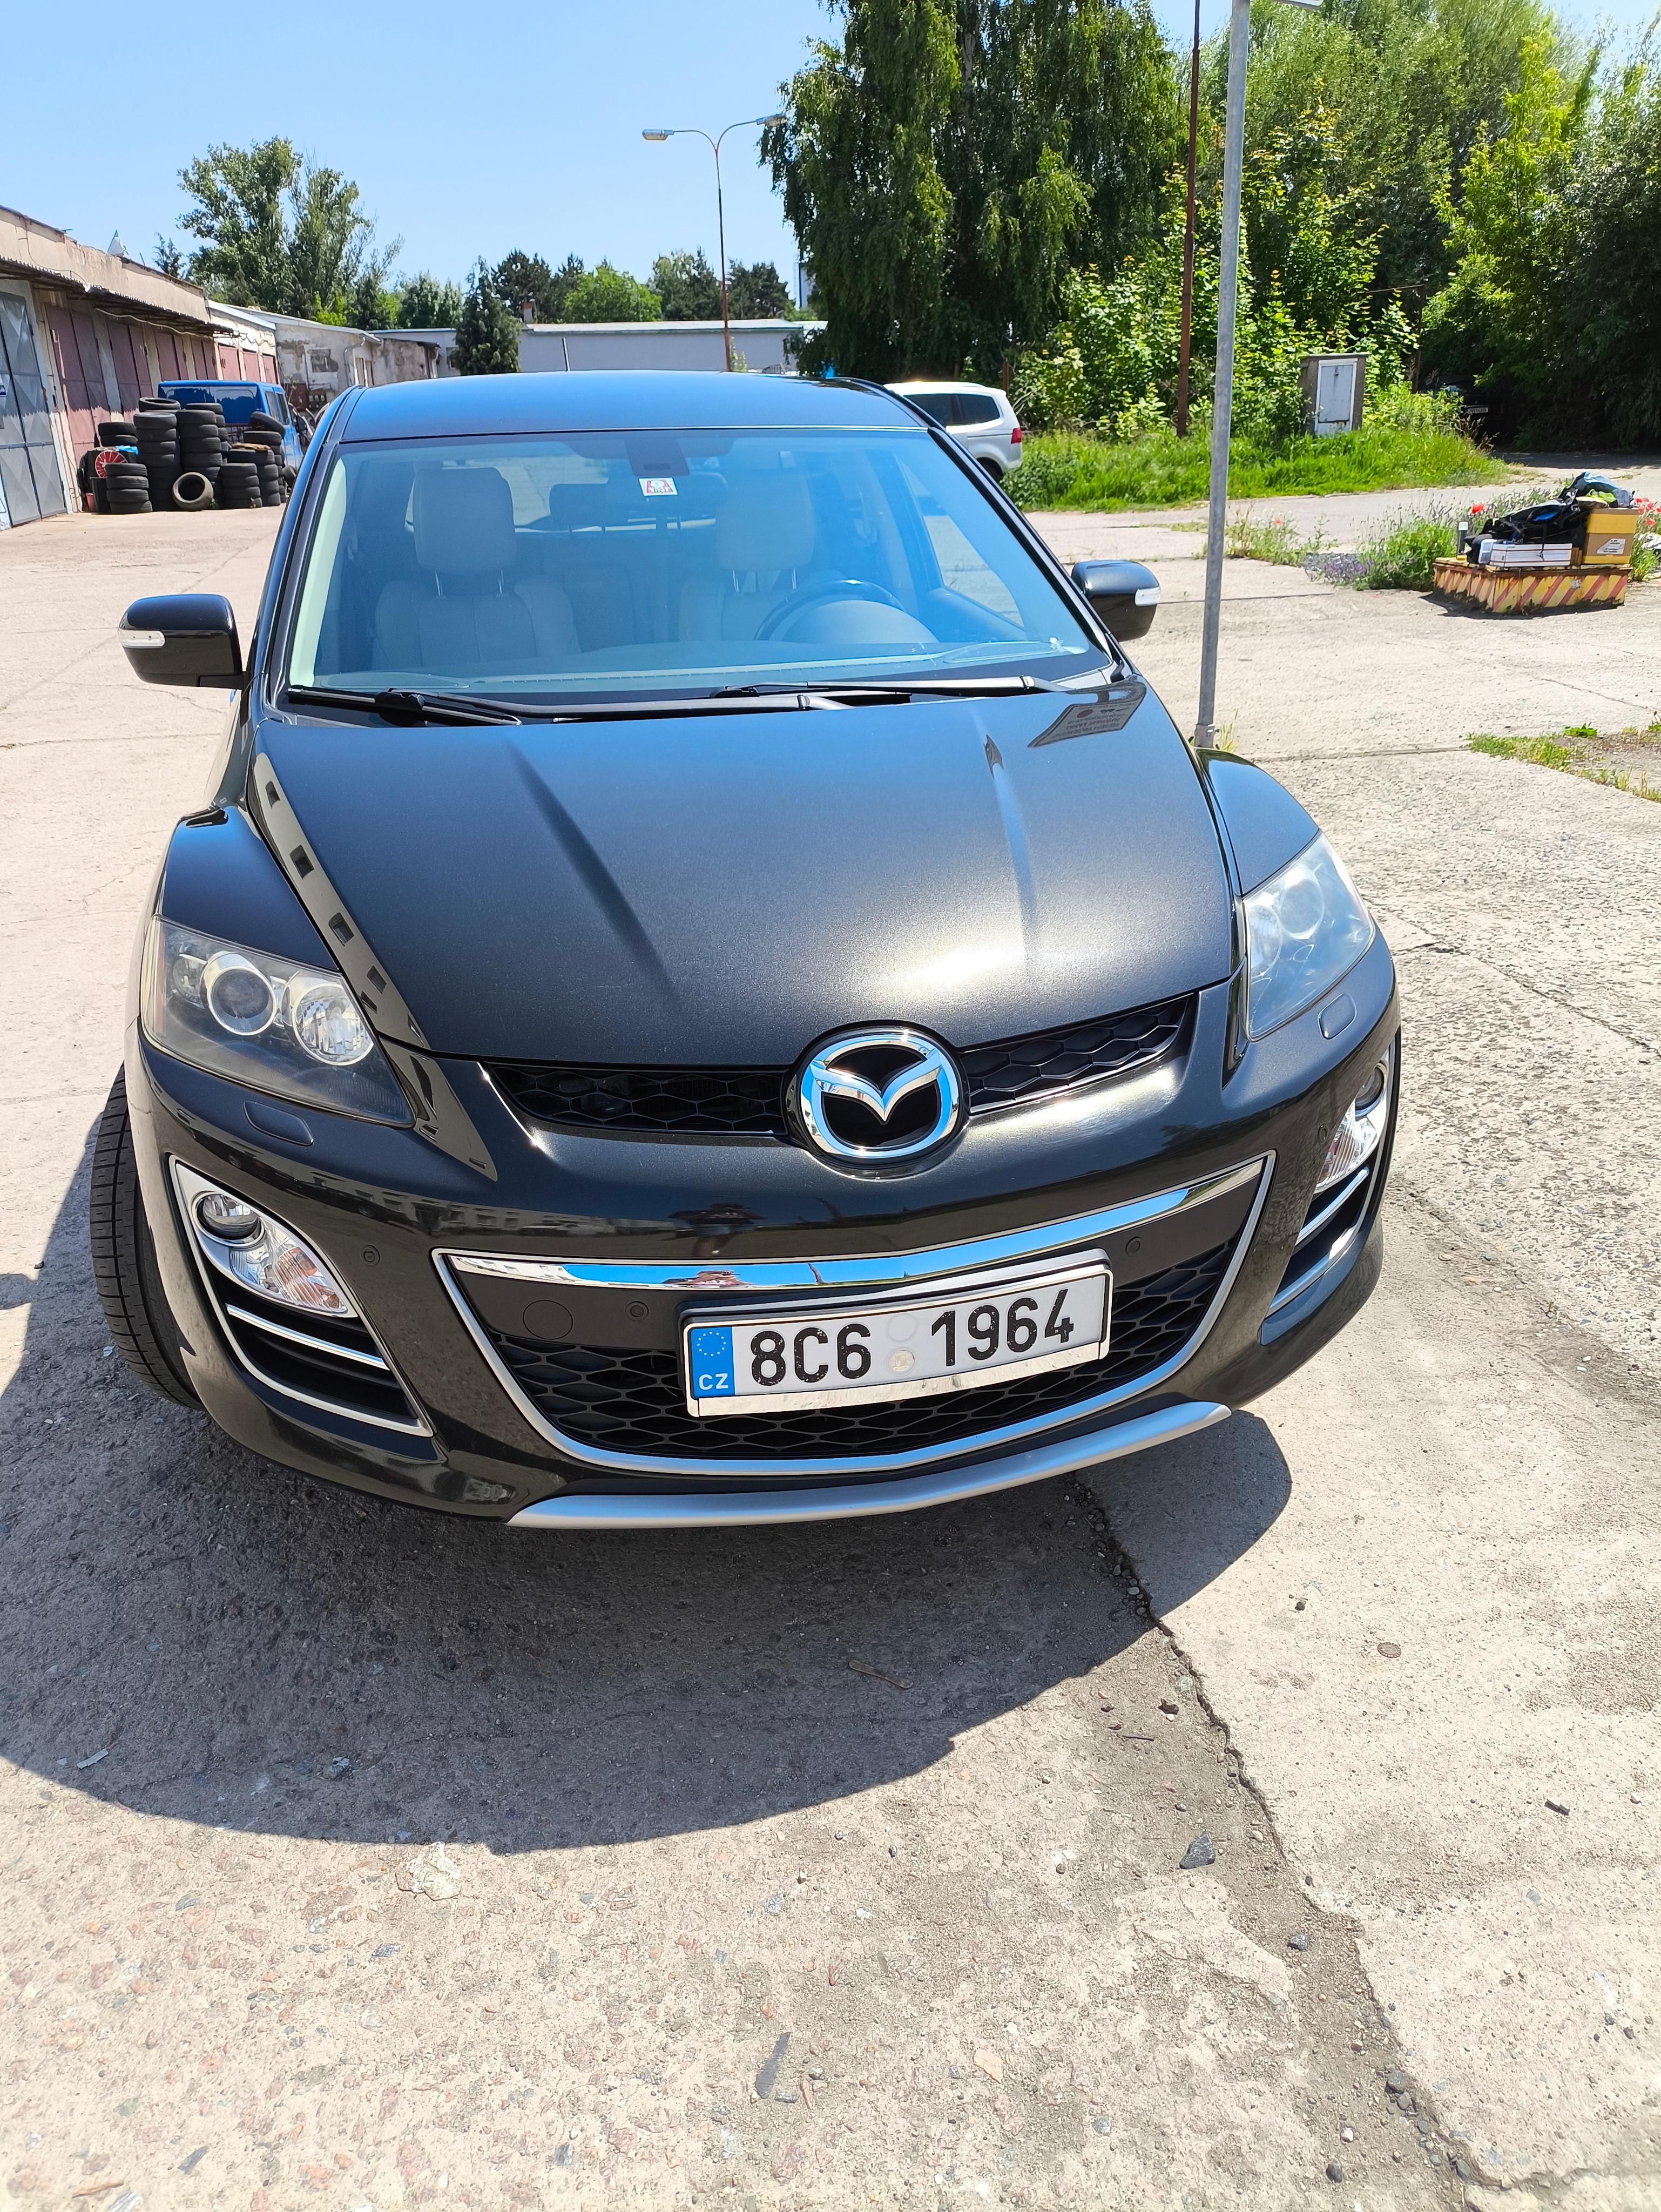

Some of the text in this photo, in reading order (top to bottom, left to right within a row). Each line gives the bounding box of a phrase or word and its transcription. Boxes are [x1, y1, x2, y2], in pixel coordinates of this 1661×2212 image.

[750, 1289, 1074, 1386] 8C6 1964
[699, 1373, 728, 1390] CZ
